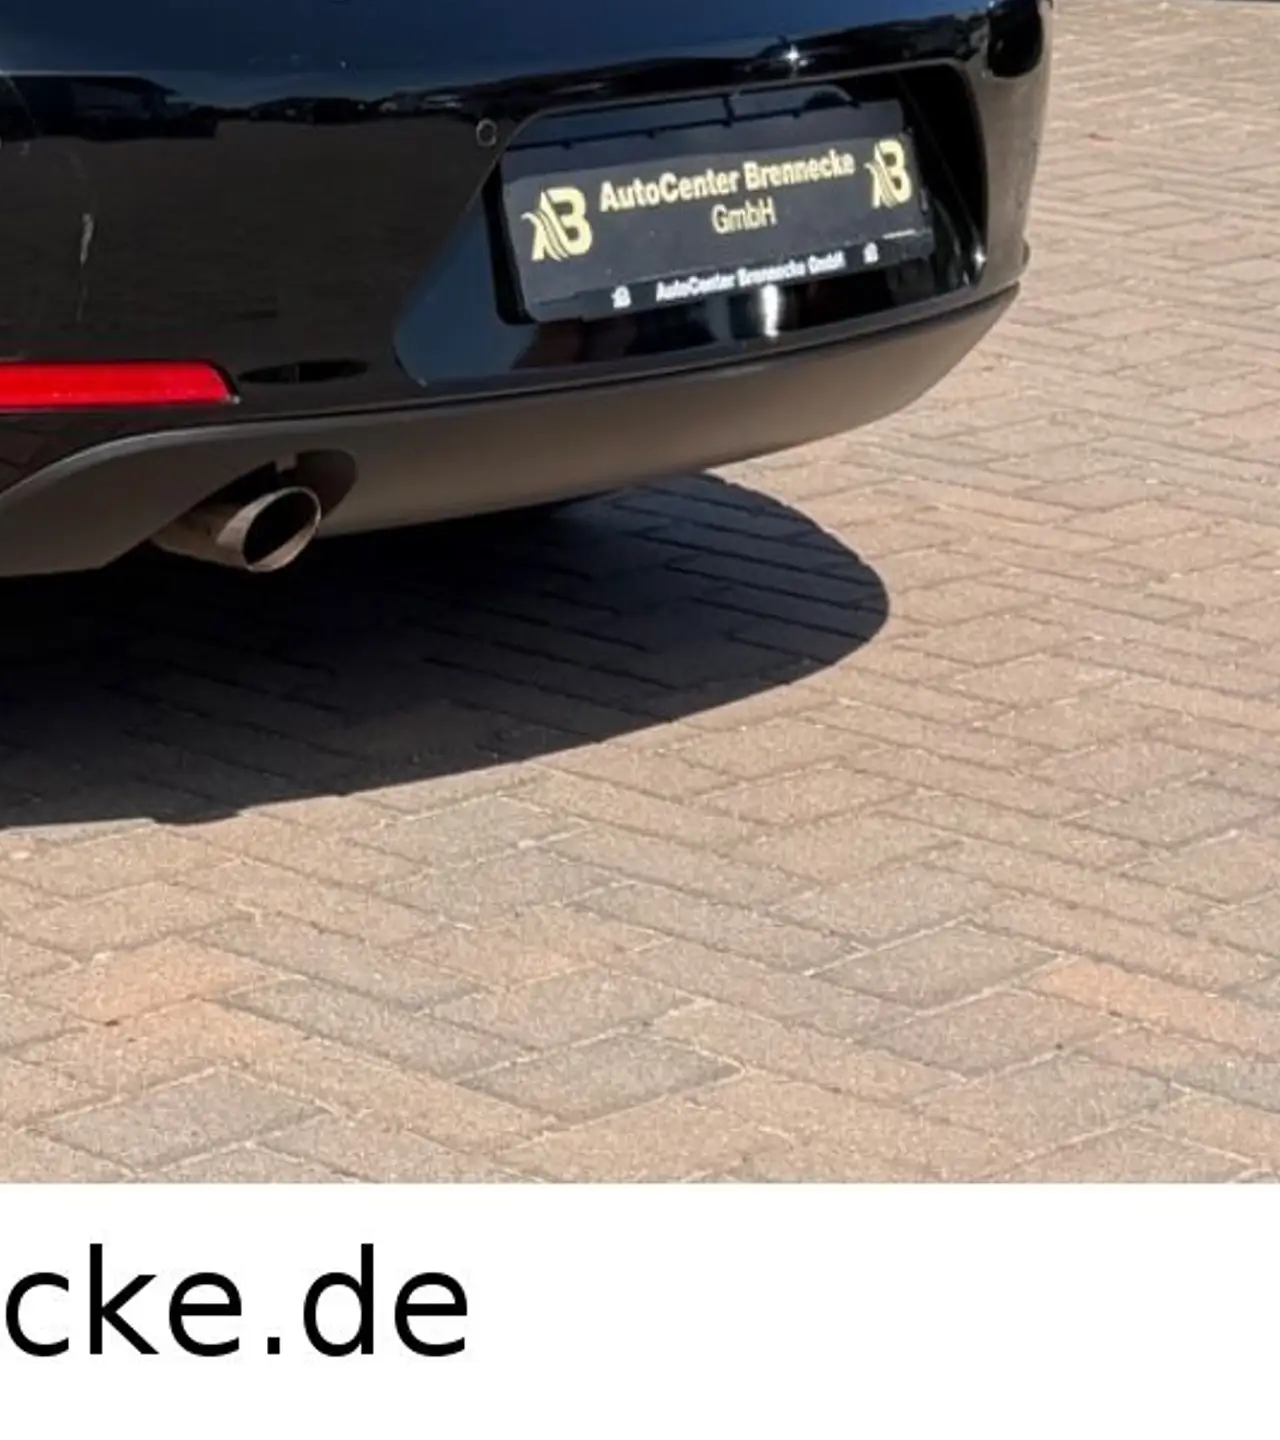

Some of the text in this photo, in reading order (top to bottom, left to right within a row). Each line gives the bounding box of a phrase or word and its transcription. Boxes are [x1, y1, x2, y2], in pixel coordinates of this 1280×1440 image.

[599, 149, 856, 213] AutoCenter Brennecke
[711, 198, 777, 235] GmbH
